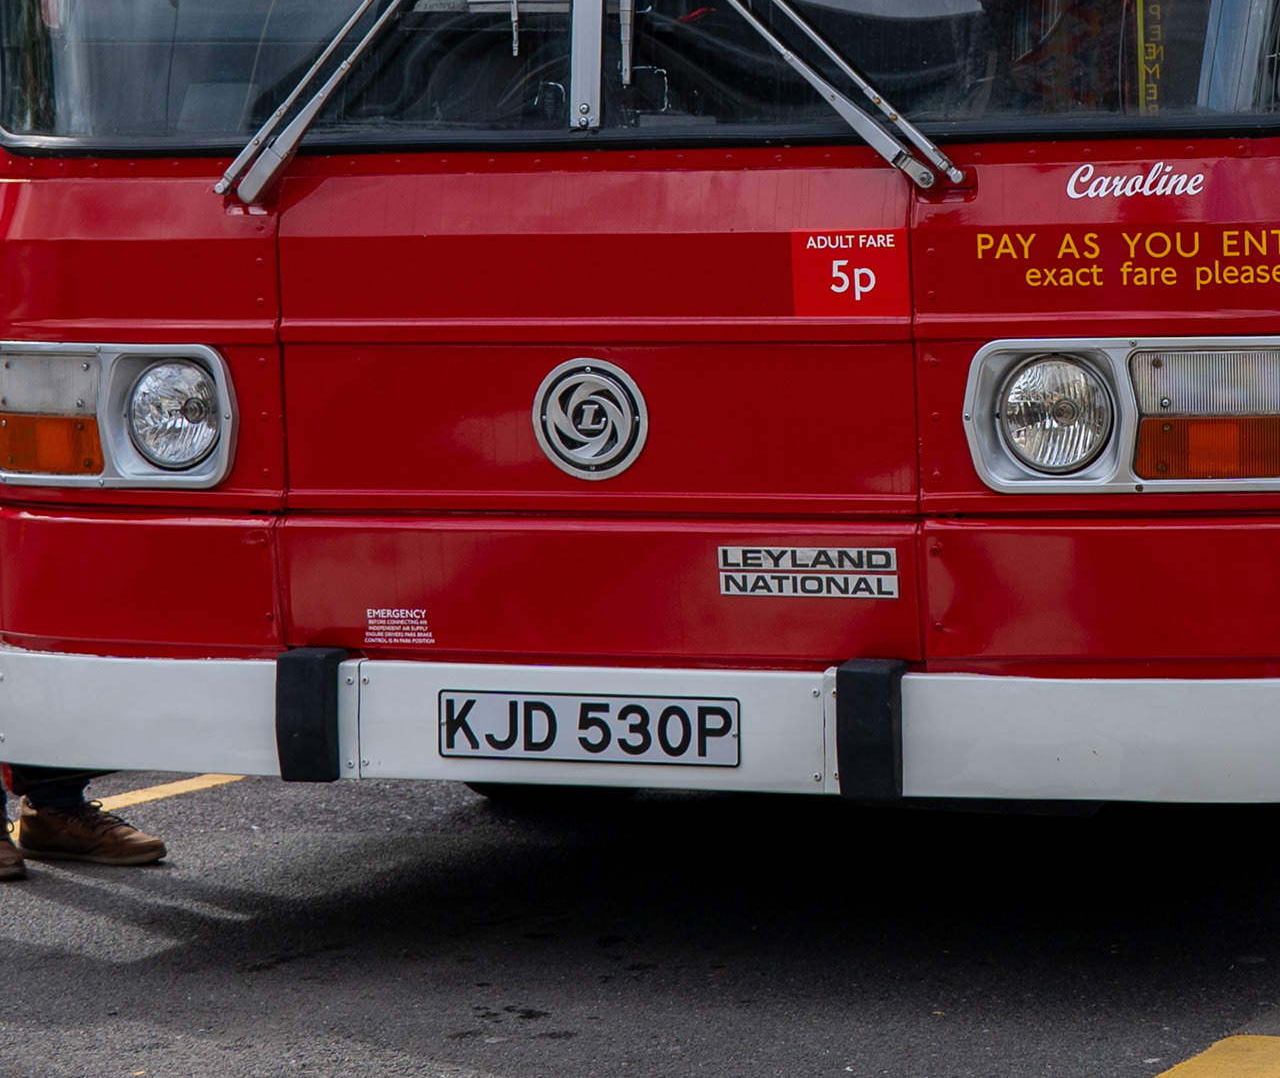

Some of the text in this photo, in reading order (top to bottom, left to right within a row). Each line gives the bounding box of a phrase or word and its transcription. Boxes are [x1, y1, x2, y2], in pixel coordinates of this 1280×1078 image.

[1066, 161, 1205, 200] Caroline
[806, 234, 896, 251] ADULT FARE
[976, 232, 1037, 260] PAY
[1057, 232, 1101, 259] AS
[1121, 231, 1201, 259] YOU
[830, 259, 877, 301] 5p
[1025, 263, 1104, 287] exact
[1120, 260, 1178, 286] fare
[721, 548, 893, 570] LEYLAND
[723, 574, 895, 597] NATIONAL
[367, 609, 427, 619] EMERGENCY
[444, 697, 734, 758] KJD 530P
